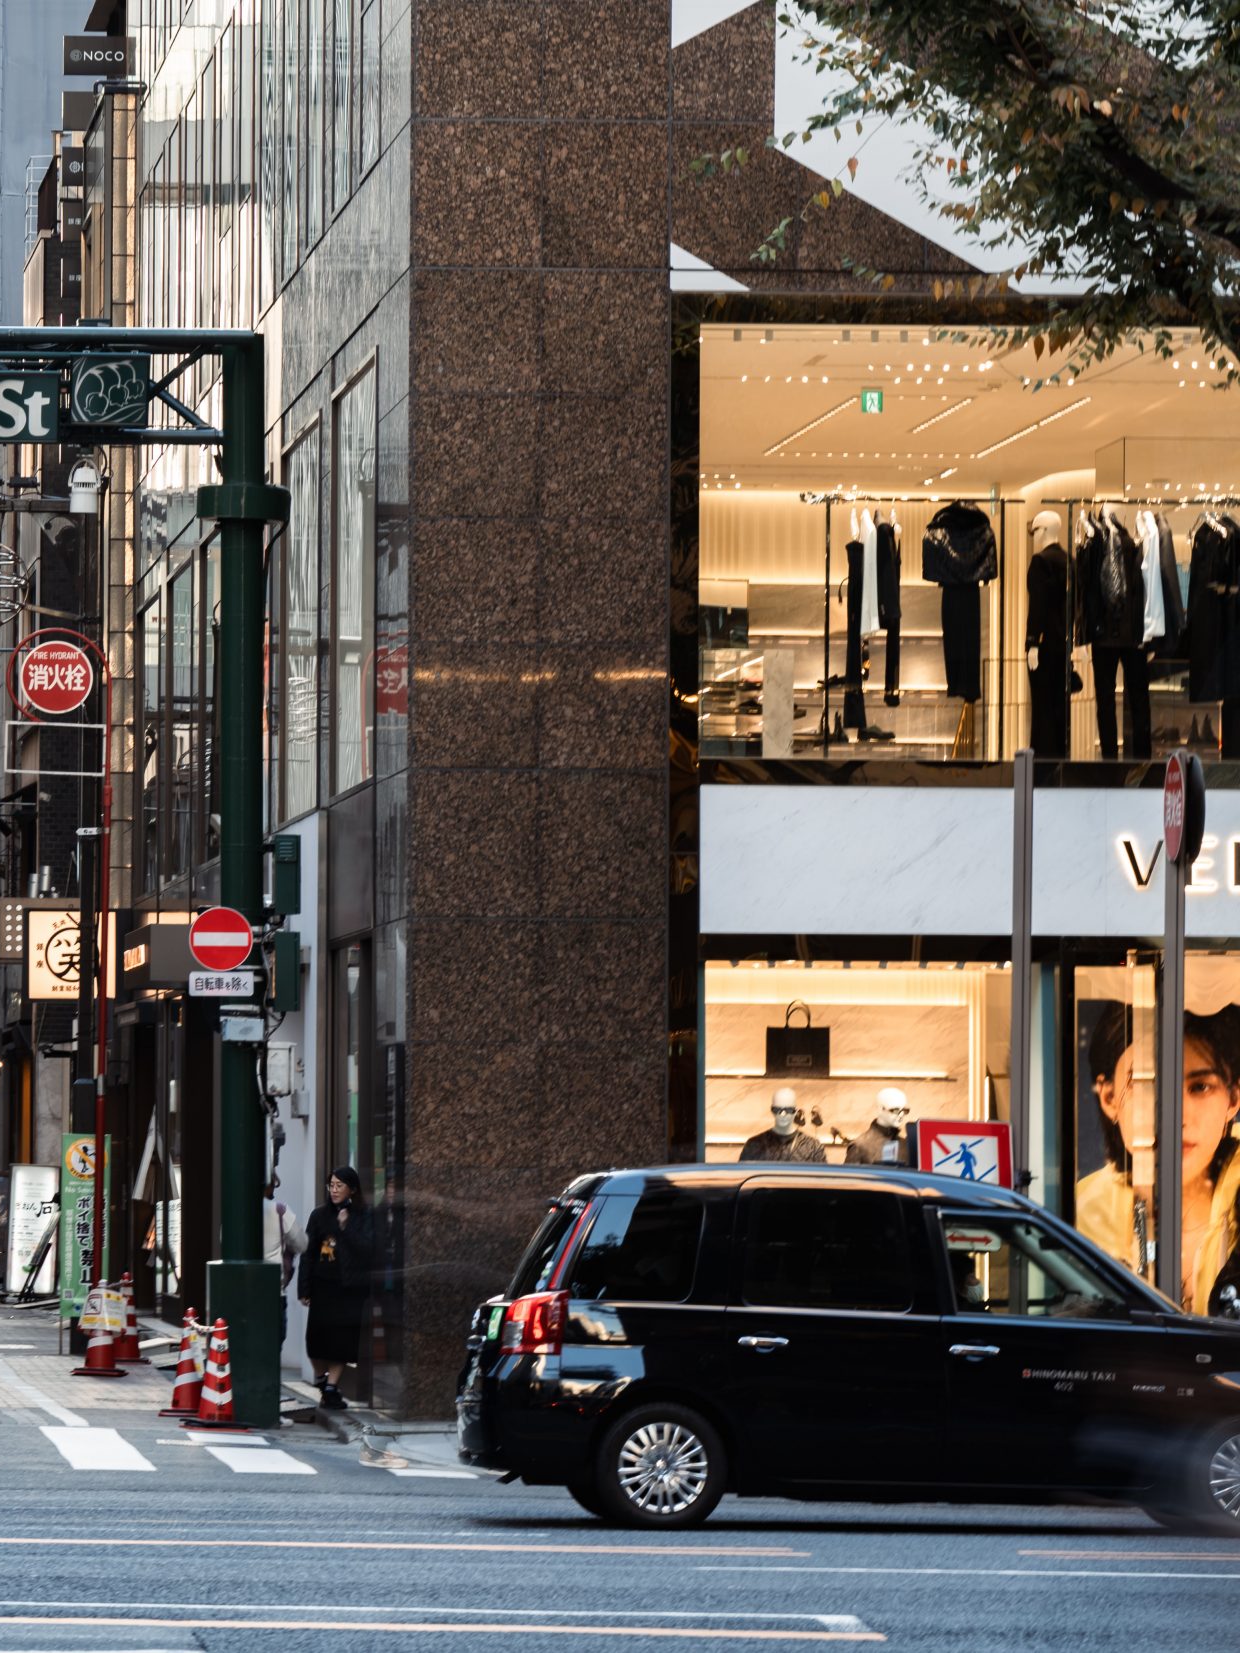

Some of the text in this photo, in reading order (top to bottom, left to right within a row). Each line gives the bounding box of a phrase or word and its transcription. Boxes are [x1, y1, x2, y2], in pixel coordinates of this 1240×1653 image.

[83, 50, 125, 62] NOCO
[33, 651, 80, 660] FIRE HYDRANT
[28, 663, 86, 691] 消火栓
[1122, 840, 1240, 886] VE
[194, 977, 249, 992] 自転車を除く
[1032, 1369, 1117, 1381] HINOMARU TAXI
